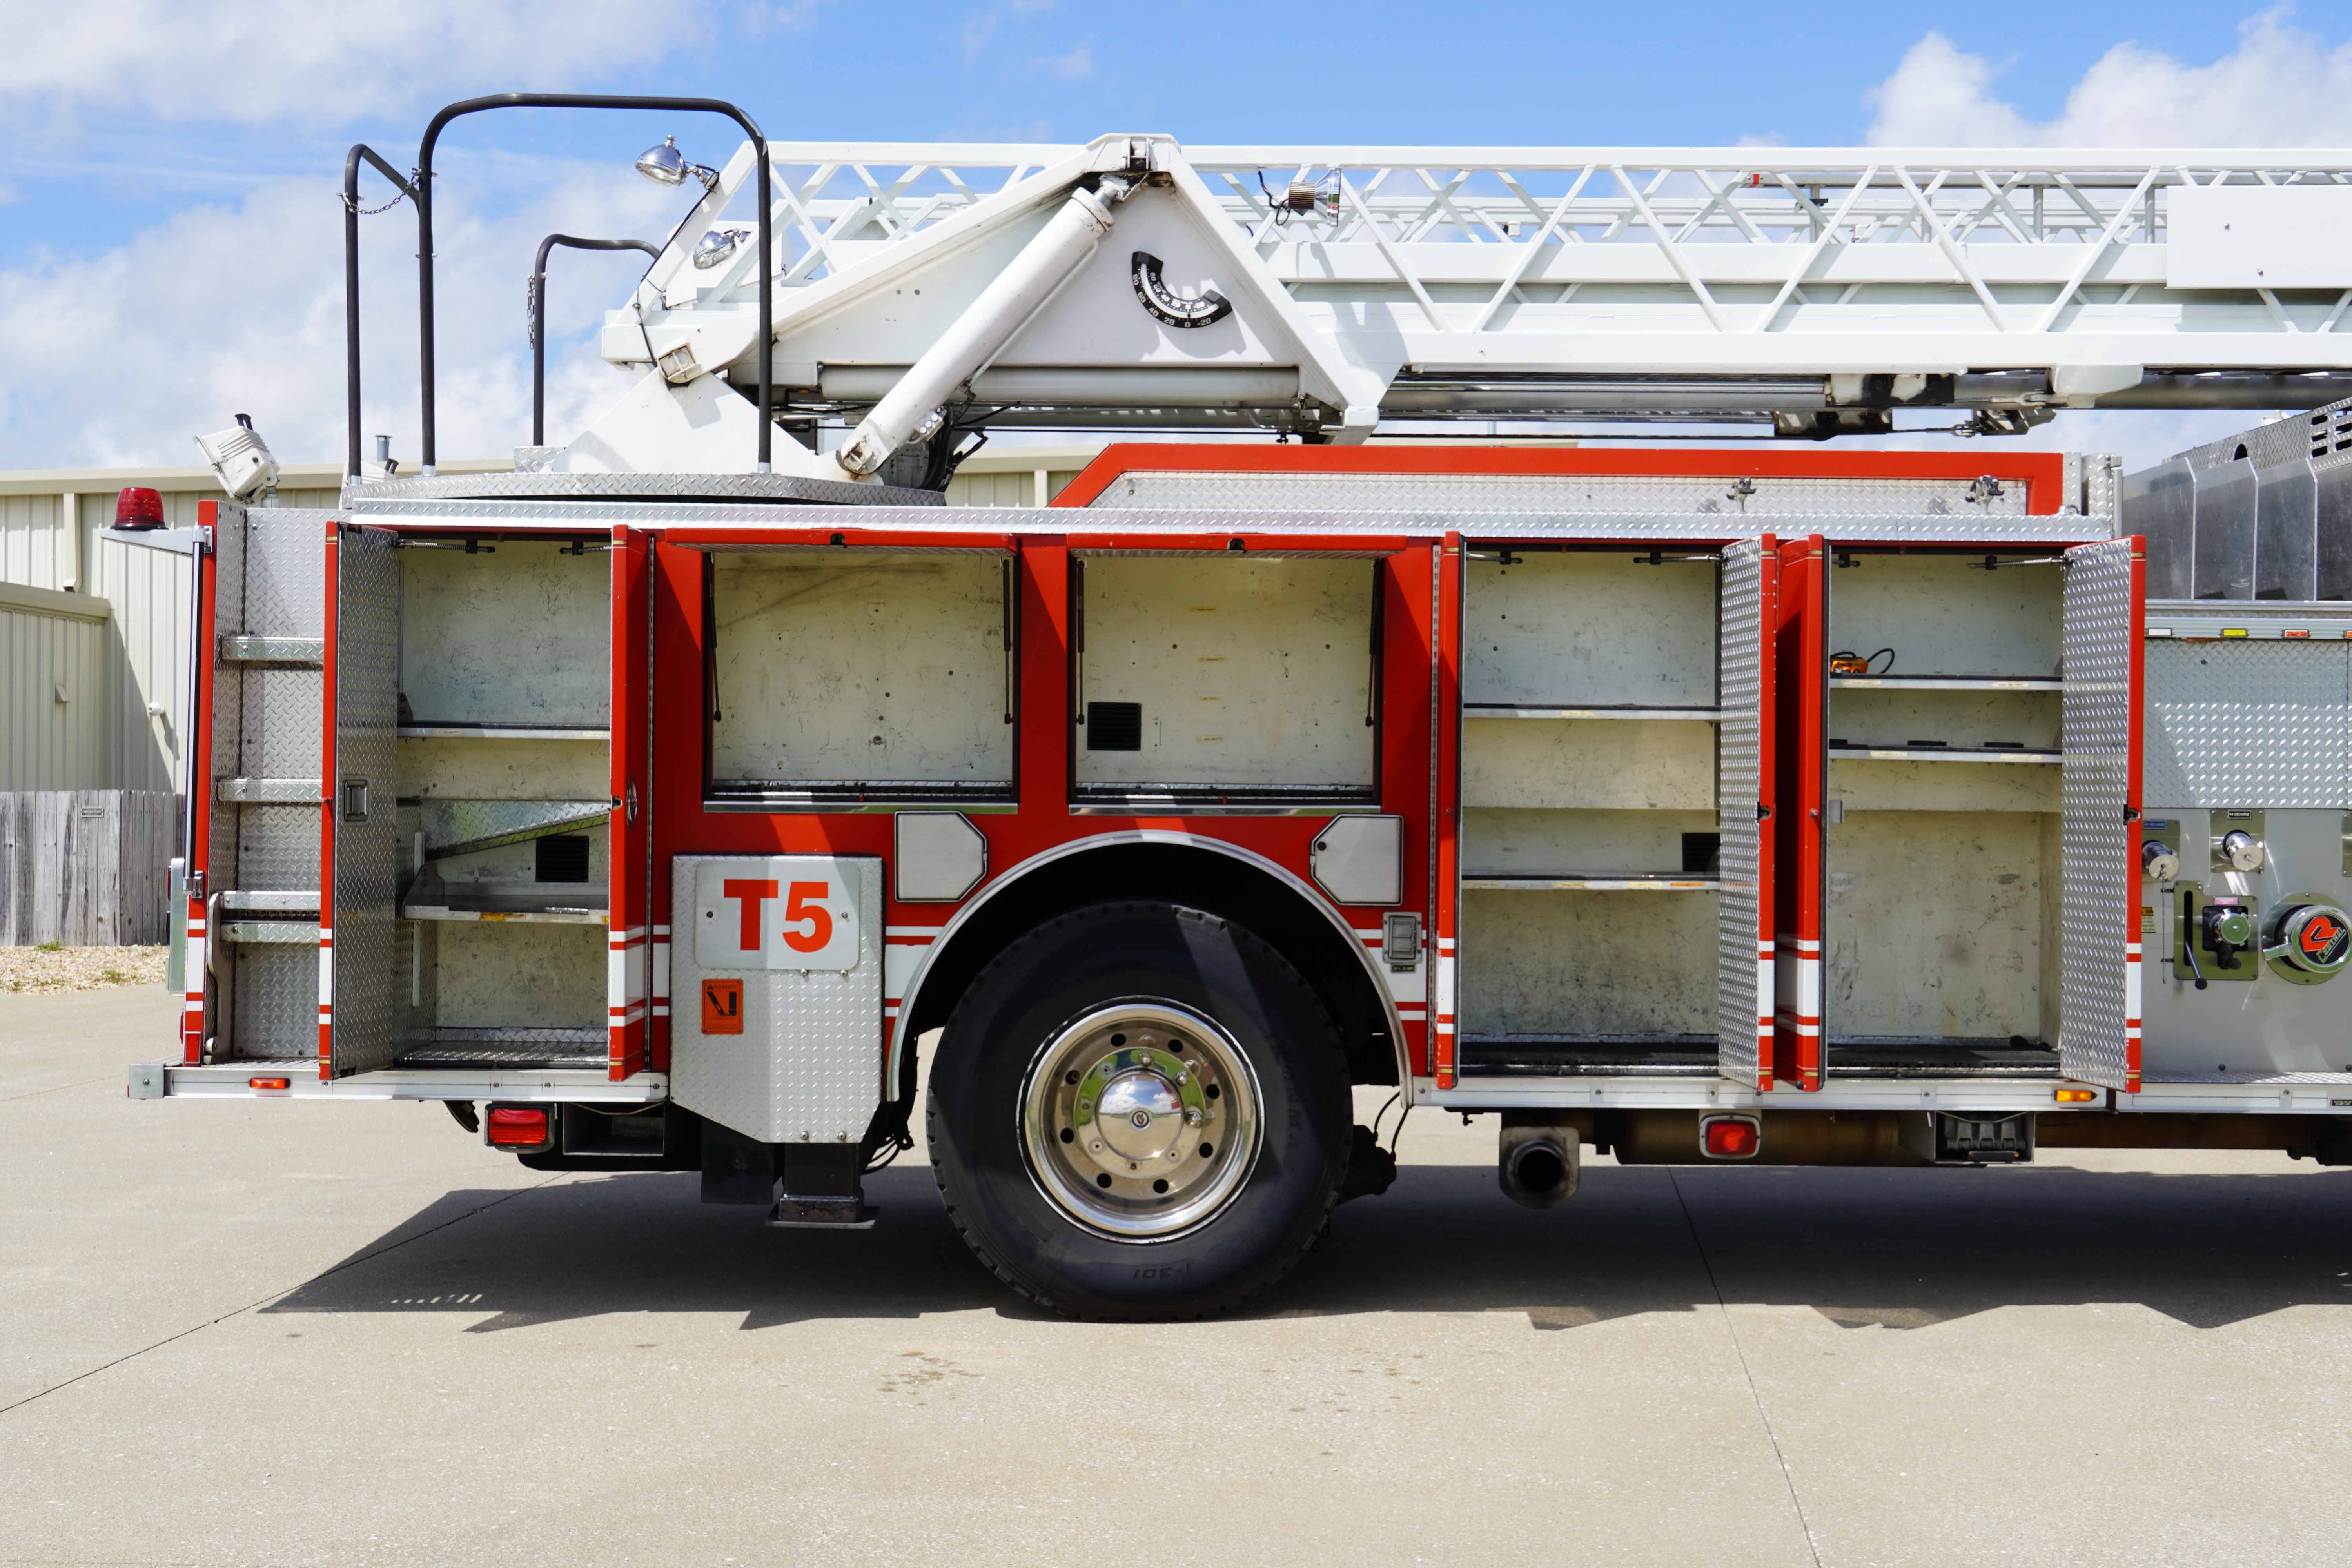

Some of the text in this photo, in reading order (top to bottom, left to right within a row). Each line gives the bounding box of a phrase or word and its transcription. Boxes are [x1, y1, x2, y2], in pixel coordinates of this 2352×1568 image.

[1132, 274, 1139, 286] 80
[1138, 291, 1147, 303] 60
[1149, 307, 1159, 318] 40
[1164, 317, 1175, 326] 20
[1197, 318, 1212, 326] -20
[1161, 294, 1170, 302] 40
[724, 878, 833, 953] T5
